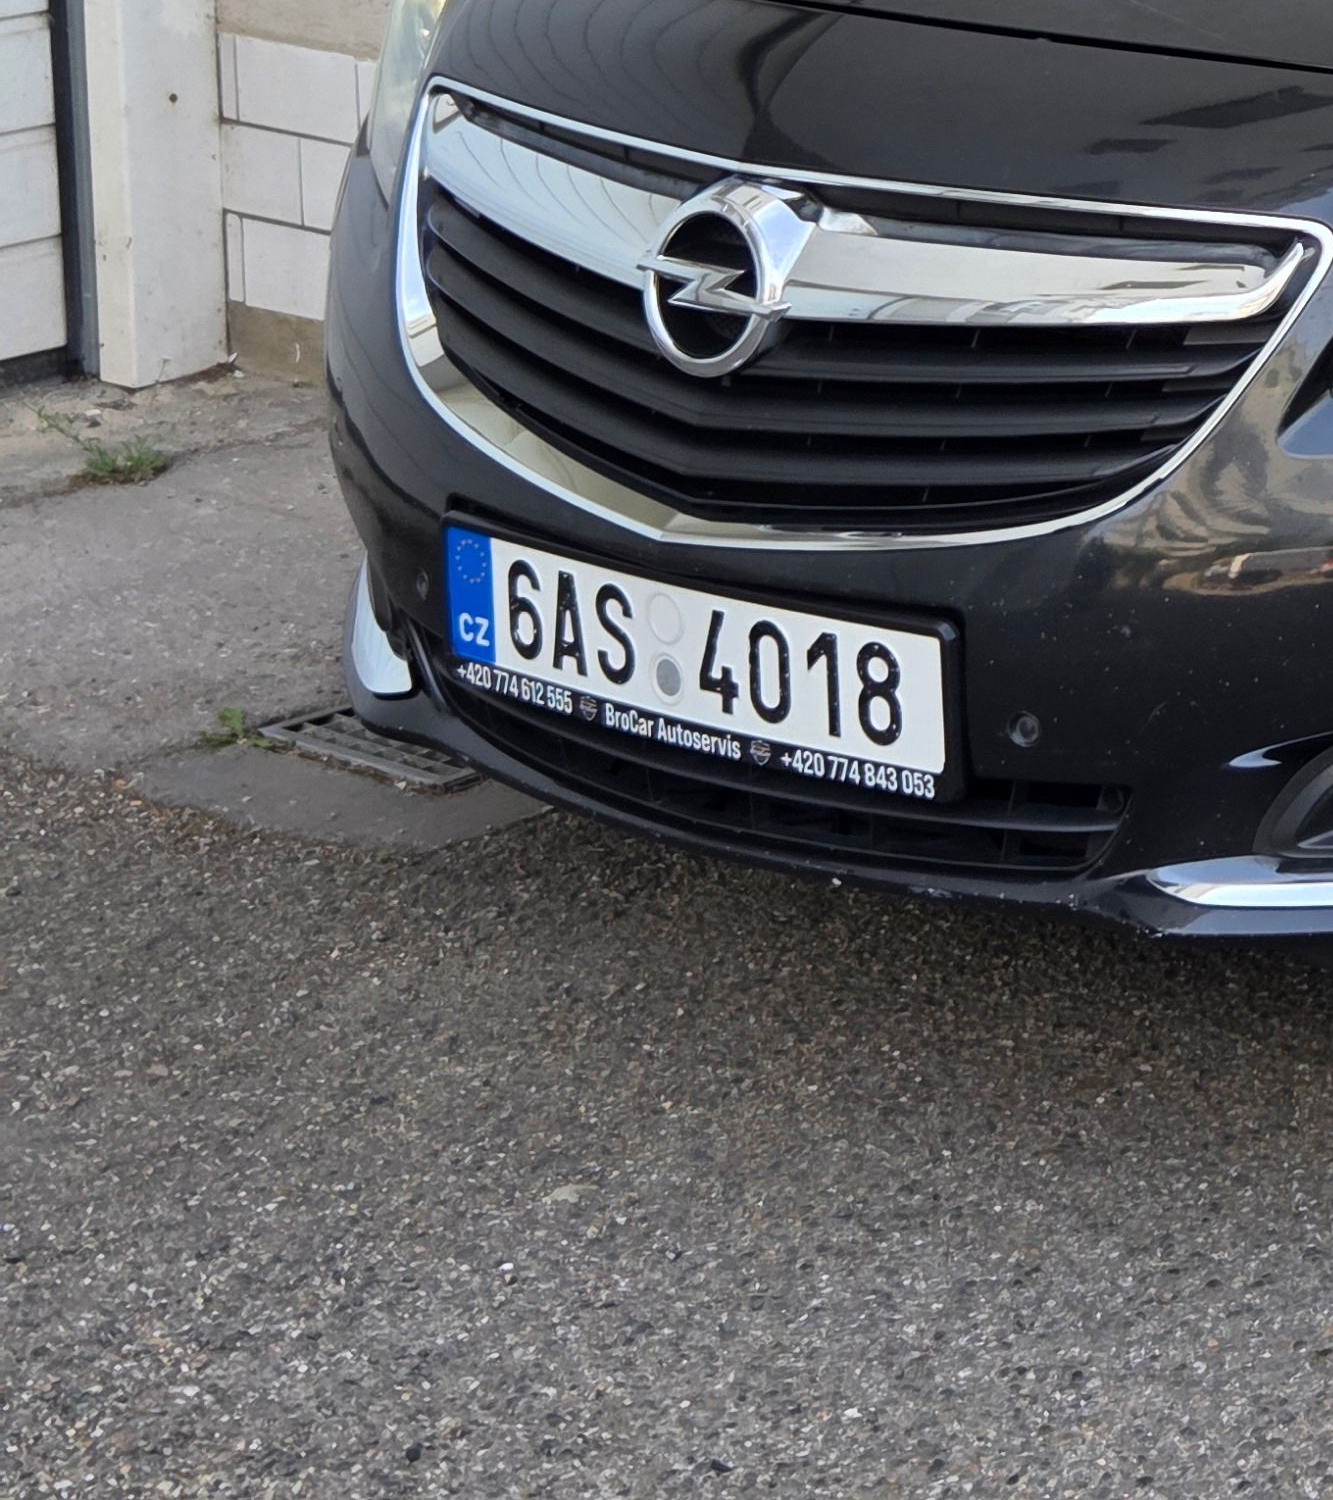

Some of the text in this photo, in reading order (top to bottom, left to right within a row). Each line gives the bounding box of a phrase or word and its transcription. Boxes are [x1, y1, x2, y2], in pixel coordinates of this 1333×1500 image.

[458, 611, 491, 647] CZ
[507, 558, 904, 747] 6AS 4018
[456, 661, 936, 800] +420 774 612 555 BroCar Autoservis +420 774 843 053
